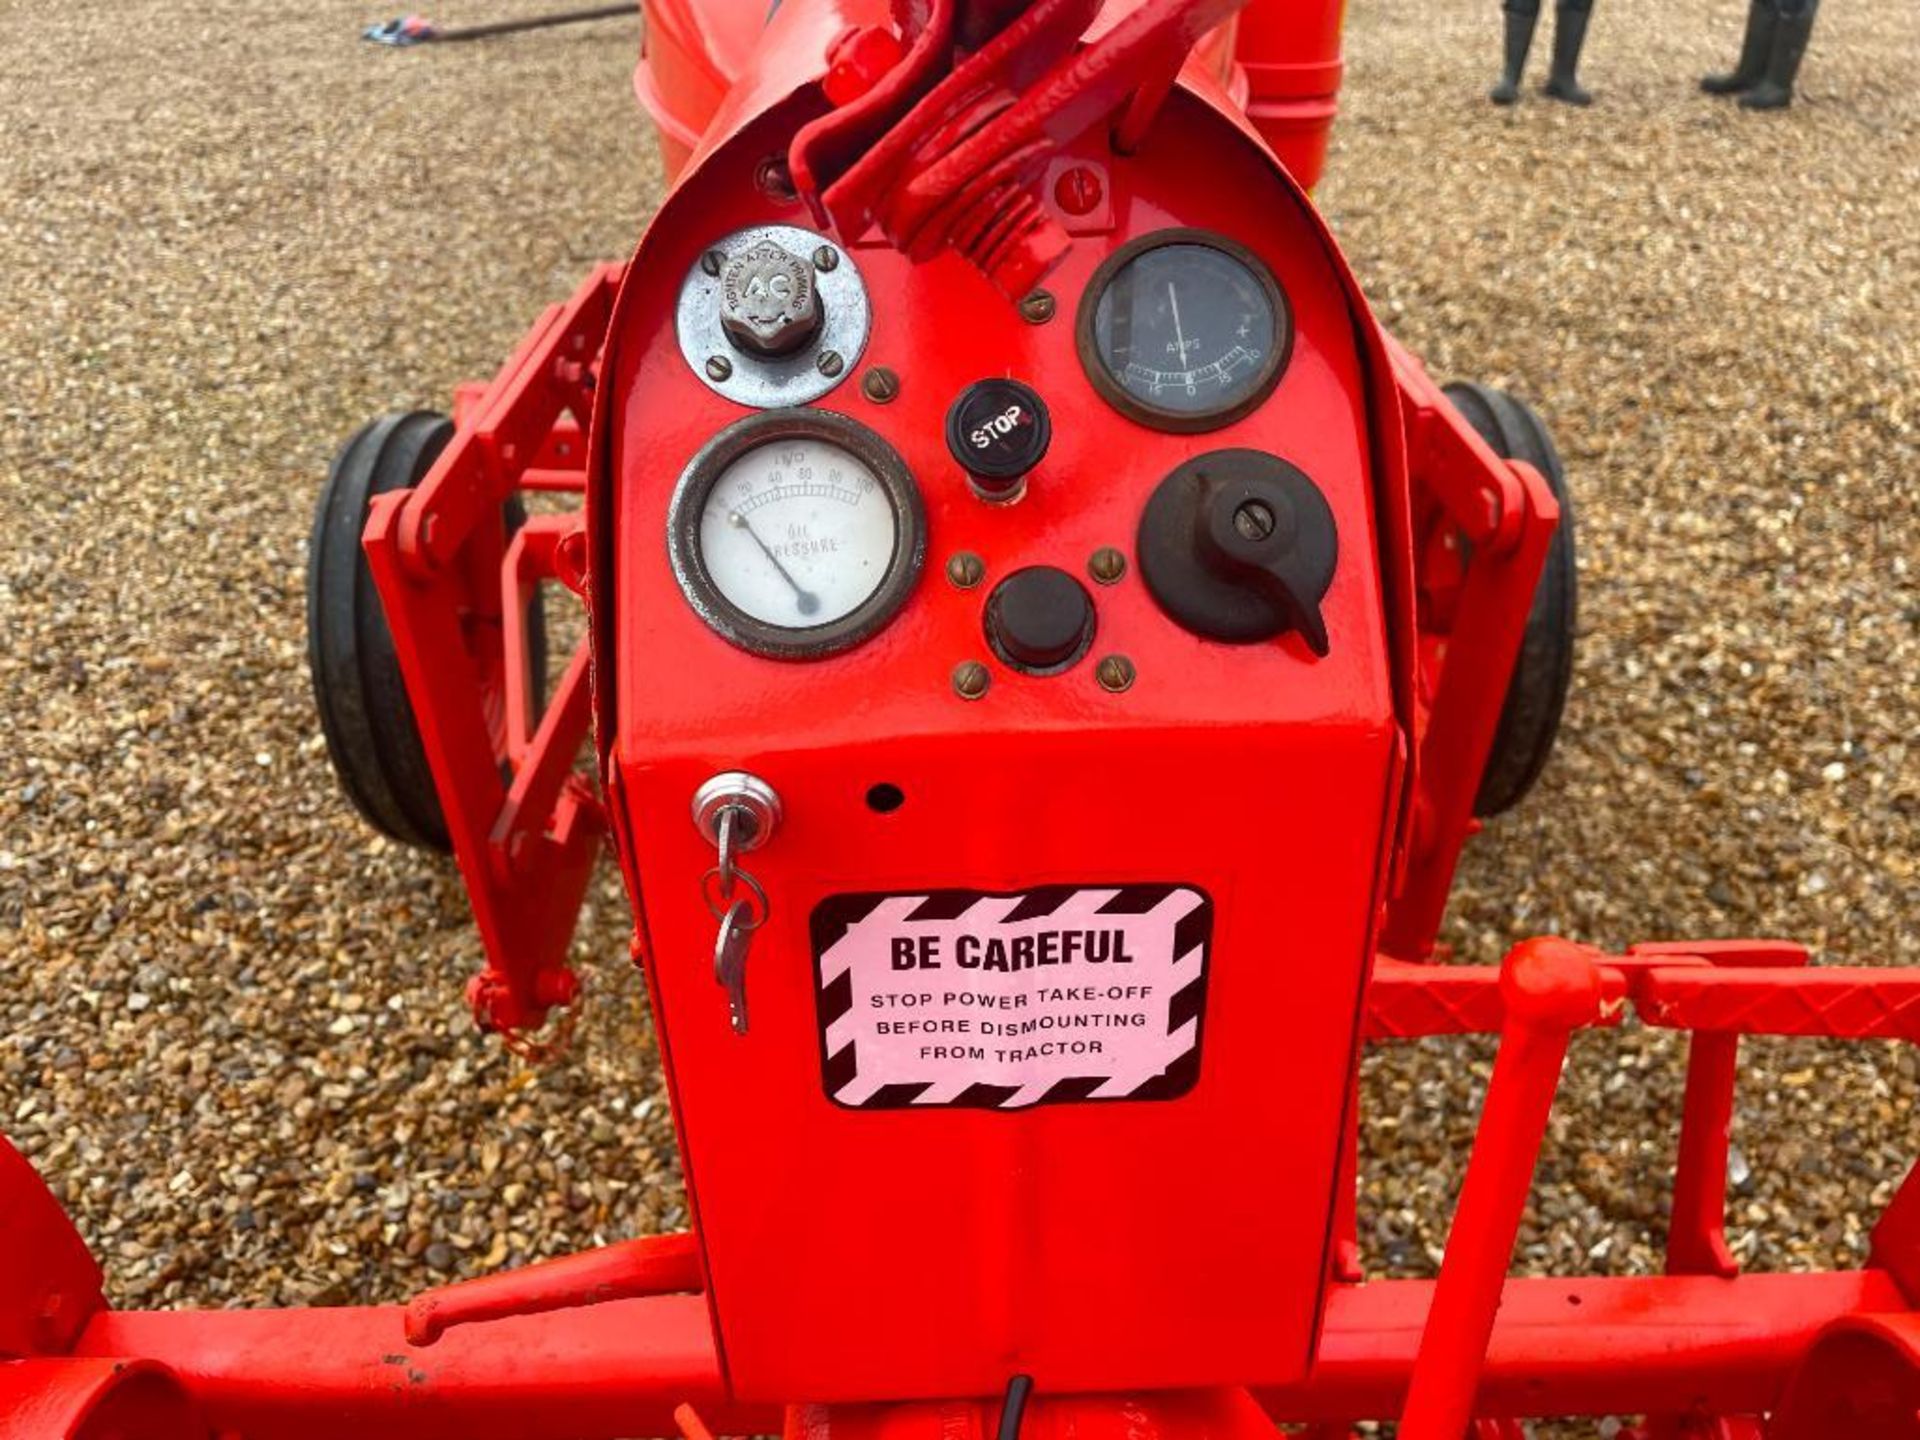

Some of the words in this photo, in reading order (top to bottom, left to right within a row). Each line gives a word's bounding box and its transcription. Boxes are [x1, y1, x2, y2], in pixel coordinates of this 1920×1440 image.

[746, 247, 788, 263] AFTER
[742, 273, 791, 301] AC
[1166, 338, 1201, 354] AMPS
[971, 405, 1021, 449] STOP
[890, 935, 942, 971] BE
[955, 929, 1134, 973] CAREFUL
[870, 993, 933, 1009] STOP
[943, 991, 1029, 1010] POWER
[1037, 985, 1153, 1003] TAKE-OFF
[876, 1019, 972, 1035] BEFORE
[980, 1012, 1147, 1037] DISMOUNTING
[920, 1046, 985, 1060] FROM
[995, 1040, 1103, 1063] TRACTOR
